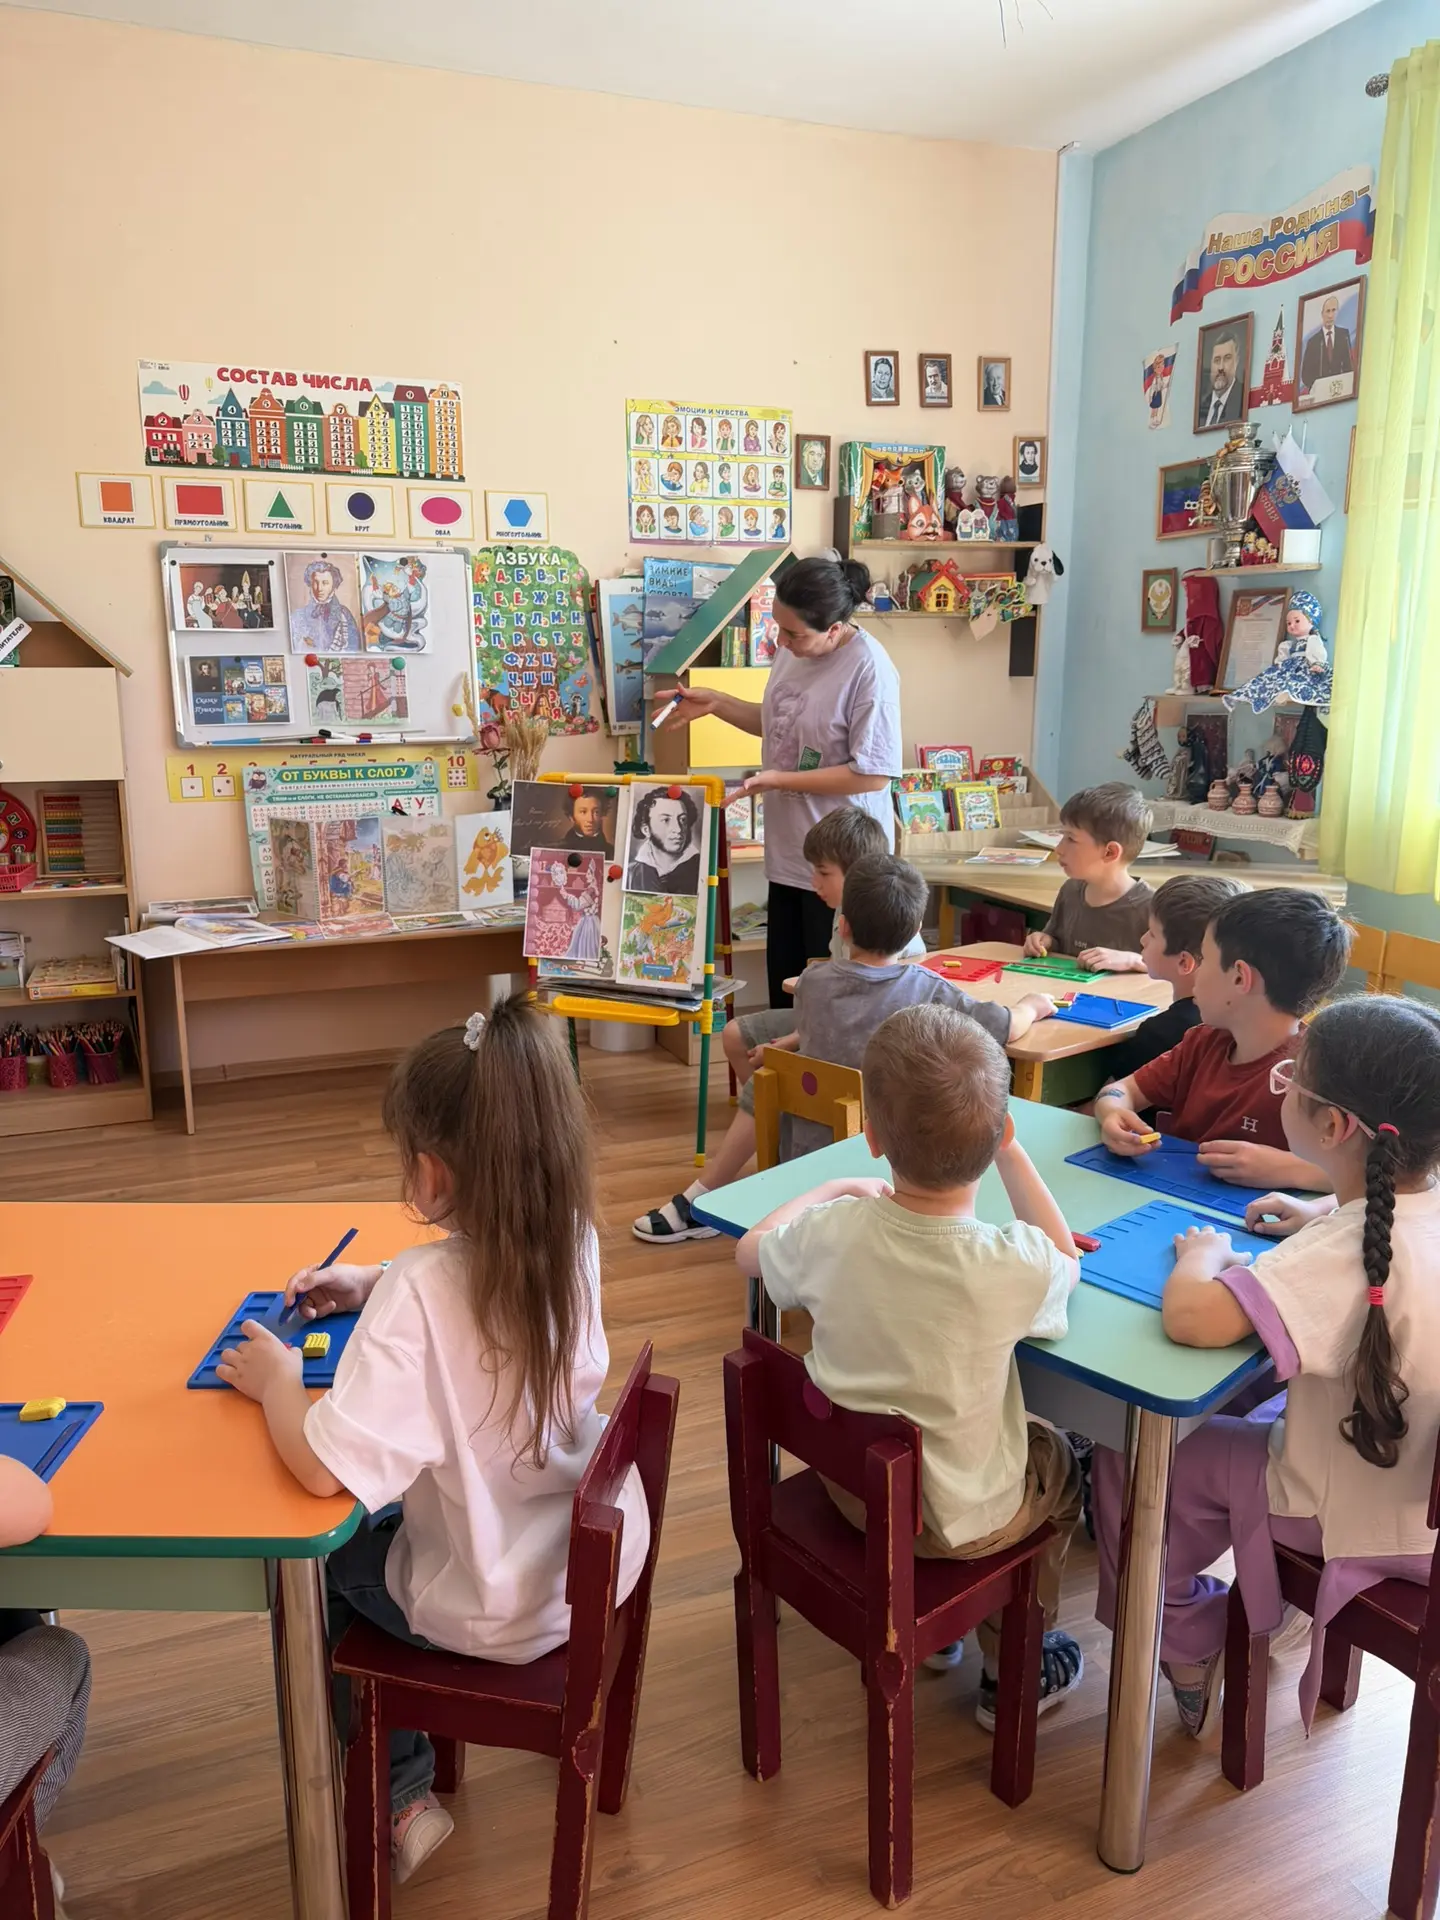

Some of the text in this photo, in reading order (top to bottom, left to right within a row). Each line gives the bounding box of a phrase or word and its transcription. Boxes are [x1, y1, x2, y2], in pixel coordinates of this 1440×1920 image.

[1207, 227, 1263, 255] Наша
[1215, 221, 1340, 287] РОССИЯ
[217, 367, 373, 392] СОСТАВ ЧИСЛА
[674, 406, 706, 414] ЭМОЦИИ
[103, 516, 135, 524] КВАДРАТ
[174, 519, 230, 527] ПРЯМОУГОЛЬНИК
[260, 521, 303, 530] ТРЕУГОЛЬНИК
[495, 552, 561, 566] АЗБУКА
[496, 568, 568, 583] А Б В Г
[649, 565, 688, 577] ЗИМНИЕ
[649, 578, 677, 588] ВИДЫ
[473, 588, 564, 608] Д Е Ё Ж З
[474, 609, 581, 627] И Й К Л М Н
[491, 632, 502, 646] П
[513, 632, 522, 646] Р
[533, 632, 544, 645] С
[552, 631, 563, 645] Т
[504, 652, 553, 666] Ф Х Ц
[508, 672, 518, 685] Ч
[521, 692, 534, 704] Ы
[549, 689, 557, 703] Э
[552, 707, 561, 720] Я
[447, 755, 466, 767] 10
[186, 763, 228, 776] 1 2
[282, 767, 408, 781] ОТ БУКВЫ К СЛОГУ
[414, 796, 425, 809] У
